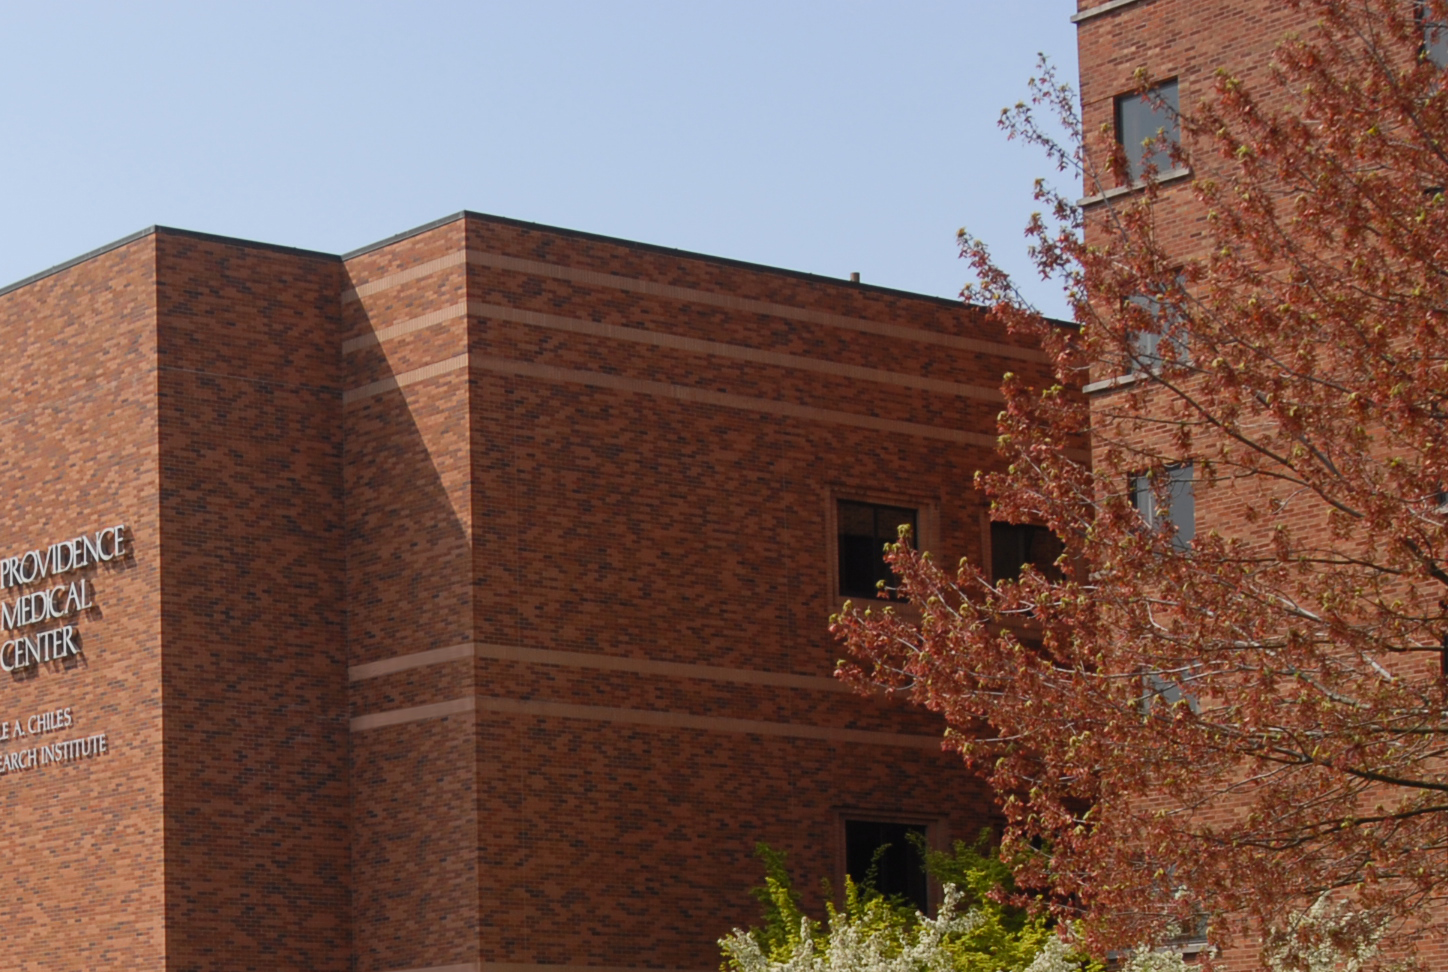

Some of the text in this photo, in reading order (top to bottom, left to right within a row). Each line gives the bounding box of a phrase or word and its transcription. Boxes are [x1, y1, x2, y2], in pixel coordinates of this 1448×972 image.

[0, 525, 125, 589] PROVIDENCE
[0, 579, 93, 631] MEDICAL
[0, 625, 81, 672] CENTER
[13, 719, 26, 738] A.
[27, 707, 72, 734] CHILES
[41, 733, 107, 764] INSTITUTE
